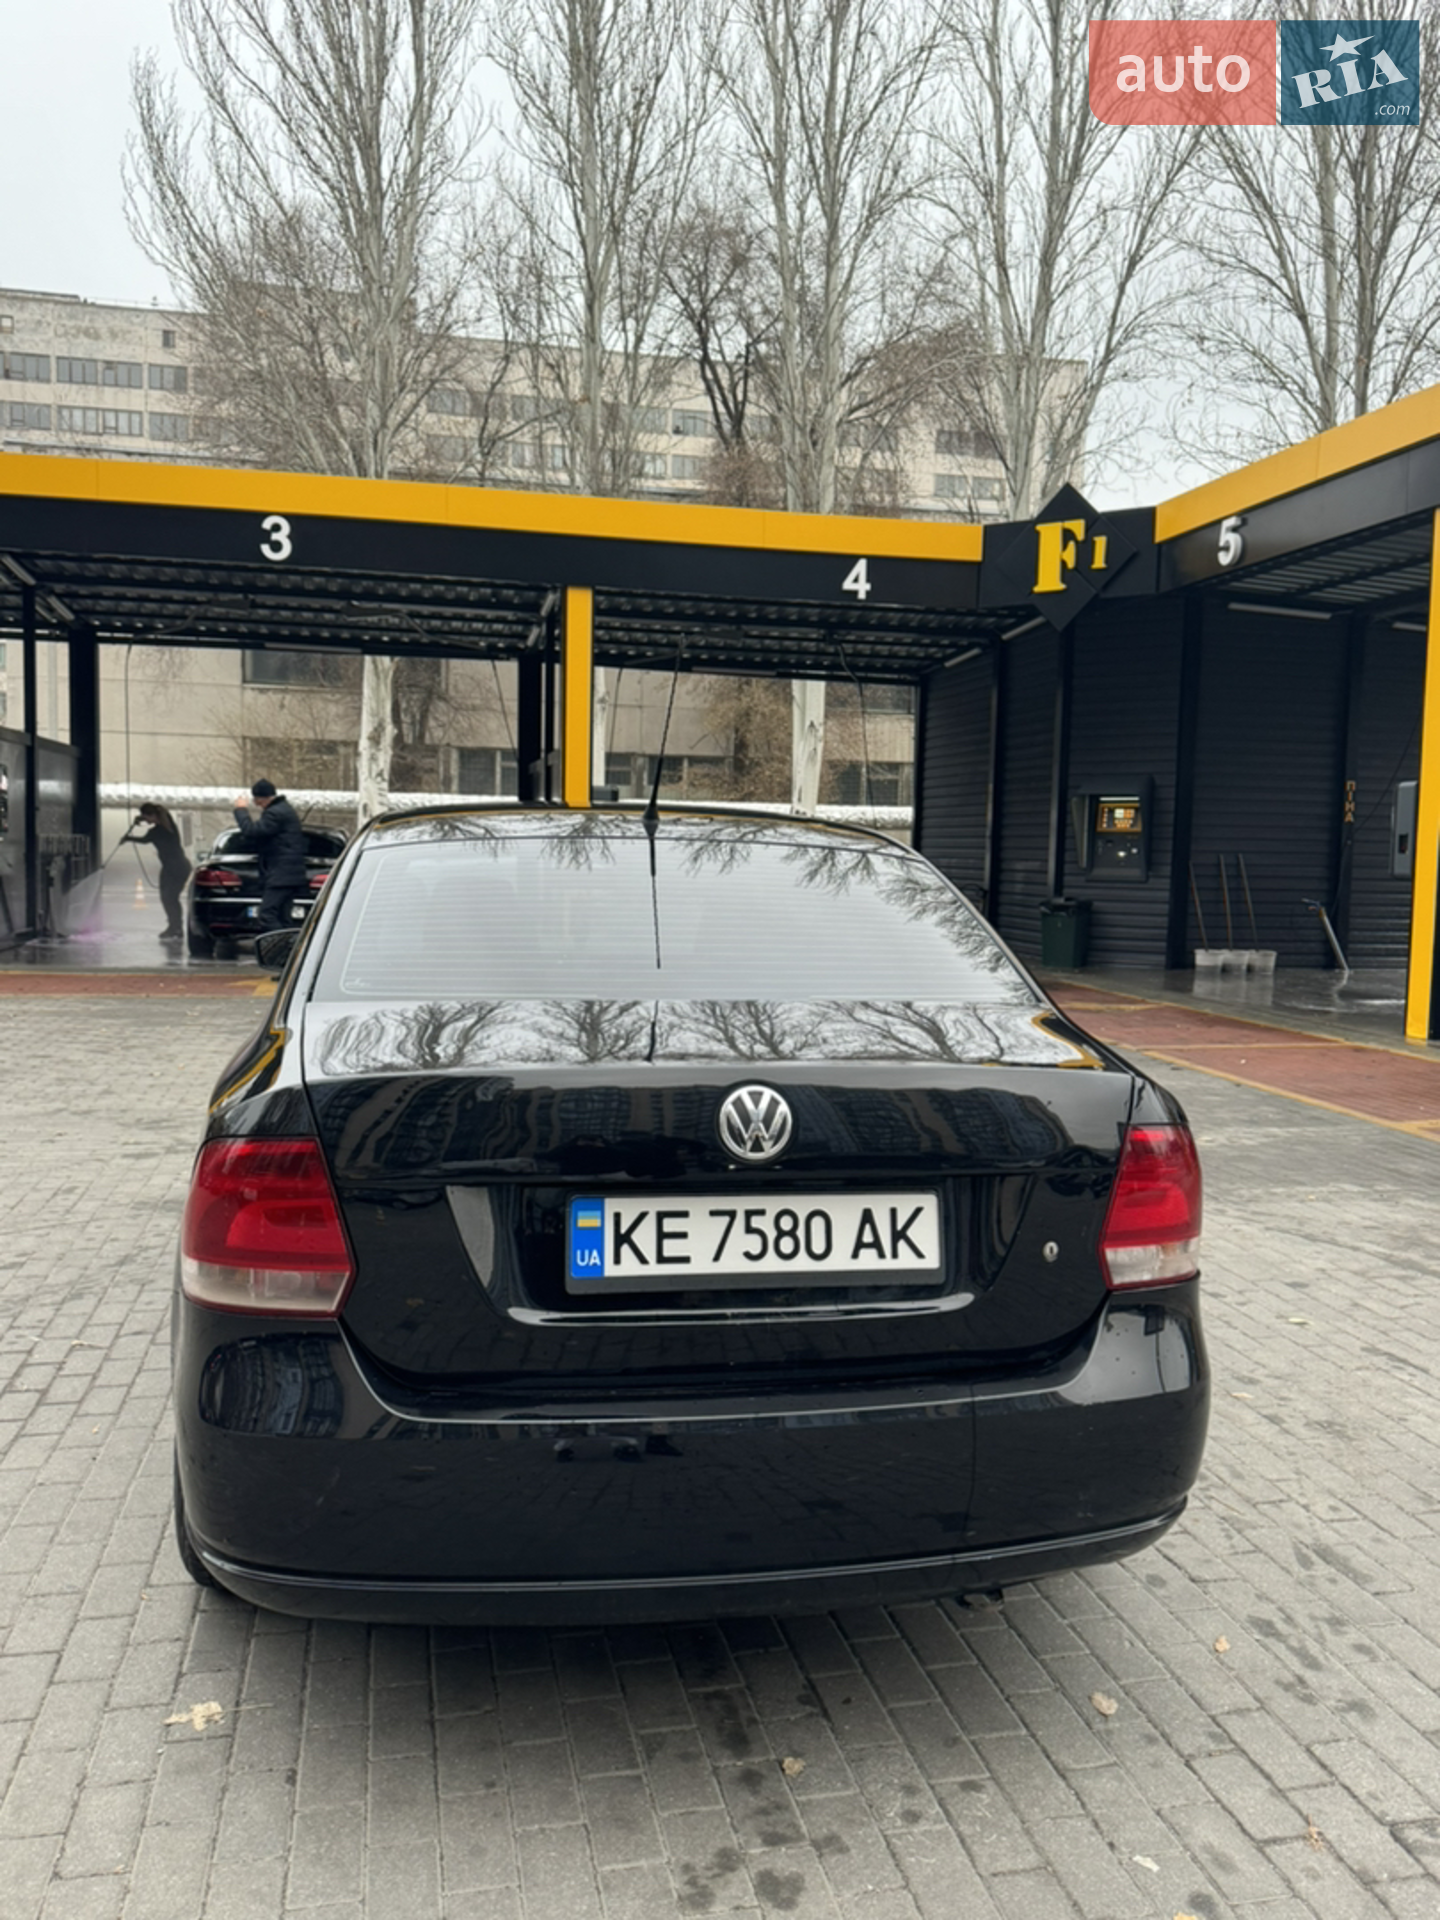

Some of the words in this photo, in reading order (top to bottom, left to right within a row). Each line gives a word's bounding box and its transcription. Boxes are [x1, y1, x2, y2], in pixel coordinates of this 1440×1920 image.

[260, 515, 293, 561] 3
[1217, 516, 1243, 566] 5
[842, 558, 871, 600] 4
[576, 1249, 601, 1266] UA
[613, 1210, 691, 1266] KE
[708, 1208, 833, 1262] 7580
[851, 1206, 926, 1260] AK
